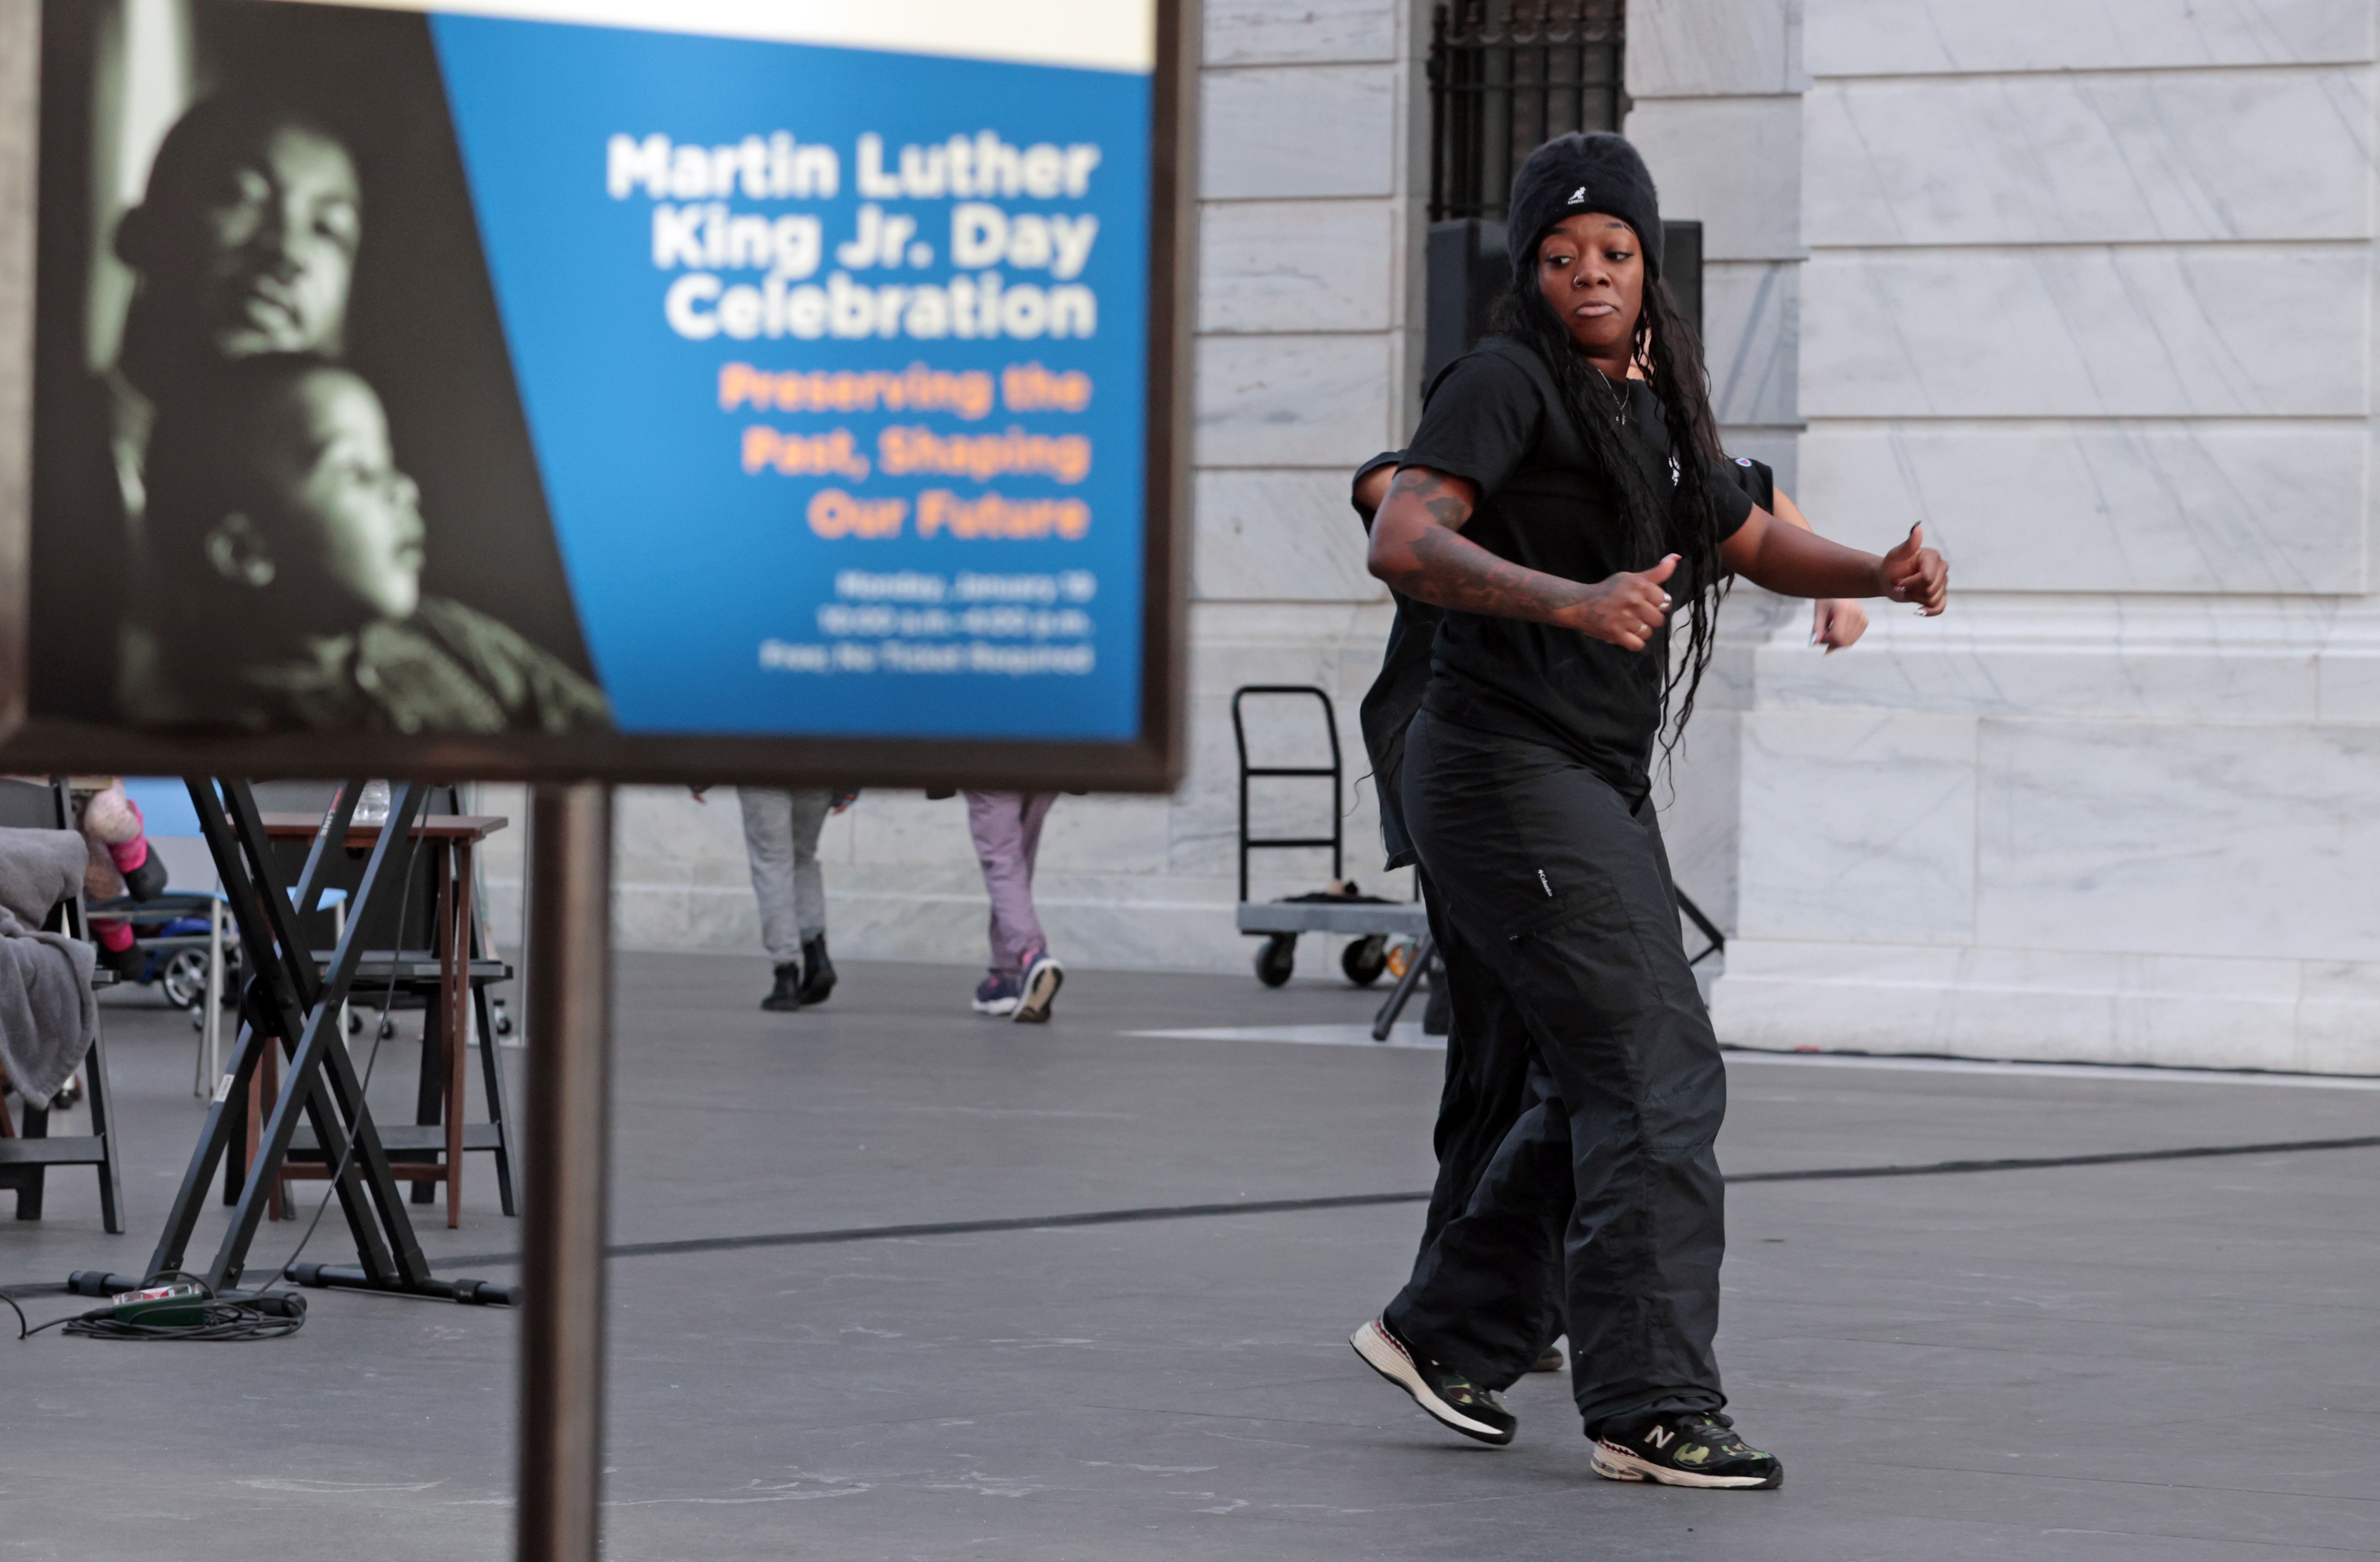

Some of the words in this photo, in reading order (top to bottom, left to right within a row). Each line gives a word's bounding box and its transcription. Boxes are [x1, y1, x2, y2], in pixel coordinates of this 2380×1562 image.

[608, 133, 839, 197] Martin
[858, 133, 1098, 197] Luther
[653, 202, 821, 278] King
[835, 203, 932, 268] Jr.
[953, 203, 1096, 278] Day
[666, 270, 1095, 338] Celebration
[719, 363, 993, 418] Preserving
[1003, 365, 1090, 411] the
[743, 427, 867, 480] Past,
[880, 427, 1090, 482] Shaping
[808, 490, 906, 538] Our
[917, 490, 1089, 538] Future
[954, 572, 1053, 601] January
